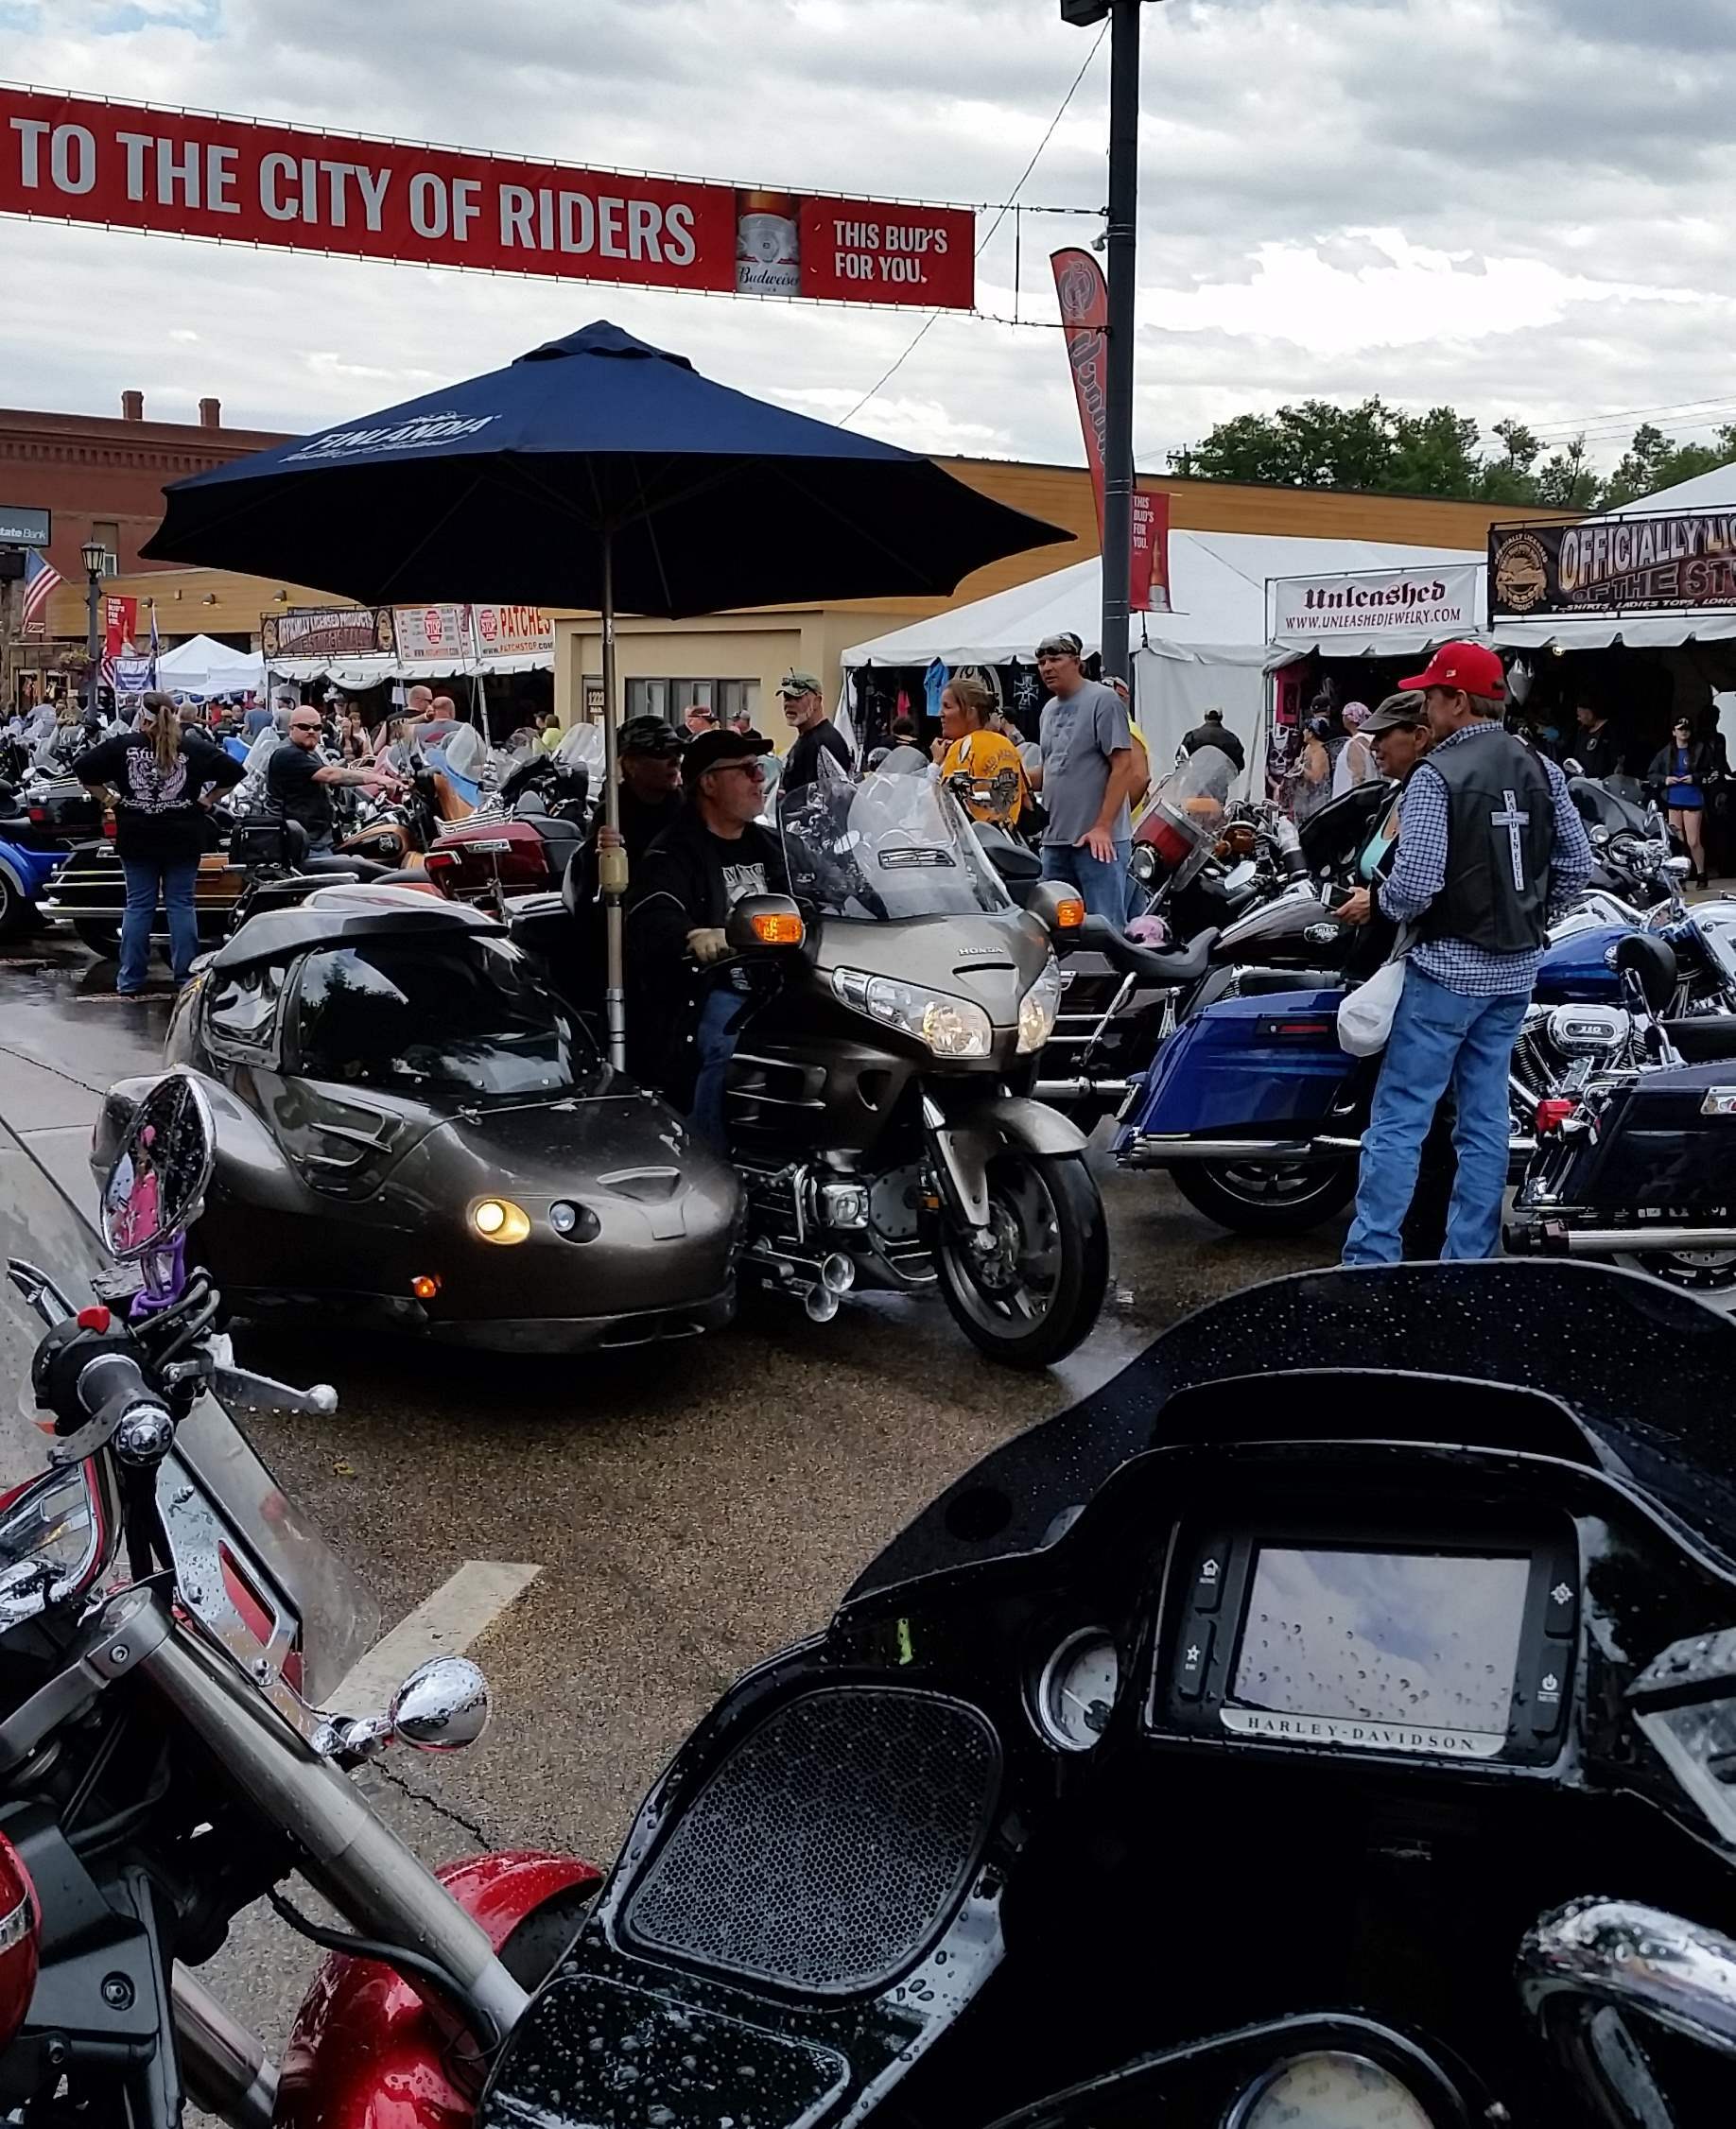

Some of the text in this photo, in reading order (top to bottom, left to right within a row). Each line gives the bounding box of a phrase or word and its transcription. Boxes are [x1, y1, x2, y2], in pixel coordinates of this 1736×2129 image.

[9, 117, 696, 266] TO THE CITY OF RIDERS
[833, 220, 948, 254] THIS BUD'S
[835, 251, 928, 284] FOR YOU.
[301, 416, 494, 452] FINLANDIA
[1133, 496, 1150, 509] THIS
[1133, 510, 1154, 523] BUD'S
[24, 528, 46, 539] Bank
[1133, 523, 1147, 536] FOR
[1561, 519, 1703, 591] OFFICIALLY
[1572, 582, 1611, 603] OF
[1611, 563, 1679, 598] THE
[1304, 579, 1446, 610] Unleashed
[1615, 600, 1658, 610] LADIES
[425, 620, 443, 634] STOP
[1285, 608, 1461, 629] WWW.UNLEASHEDJEWELRY.COM
[959, 946, 1004, 955] HONDA
[1577, 1026, 1604, 1035] 110
[1248, 1717, 1475, 1751] HARLEY-DAVIDSON
